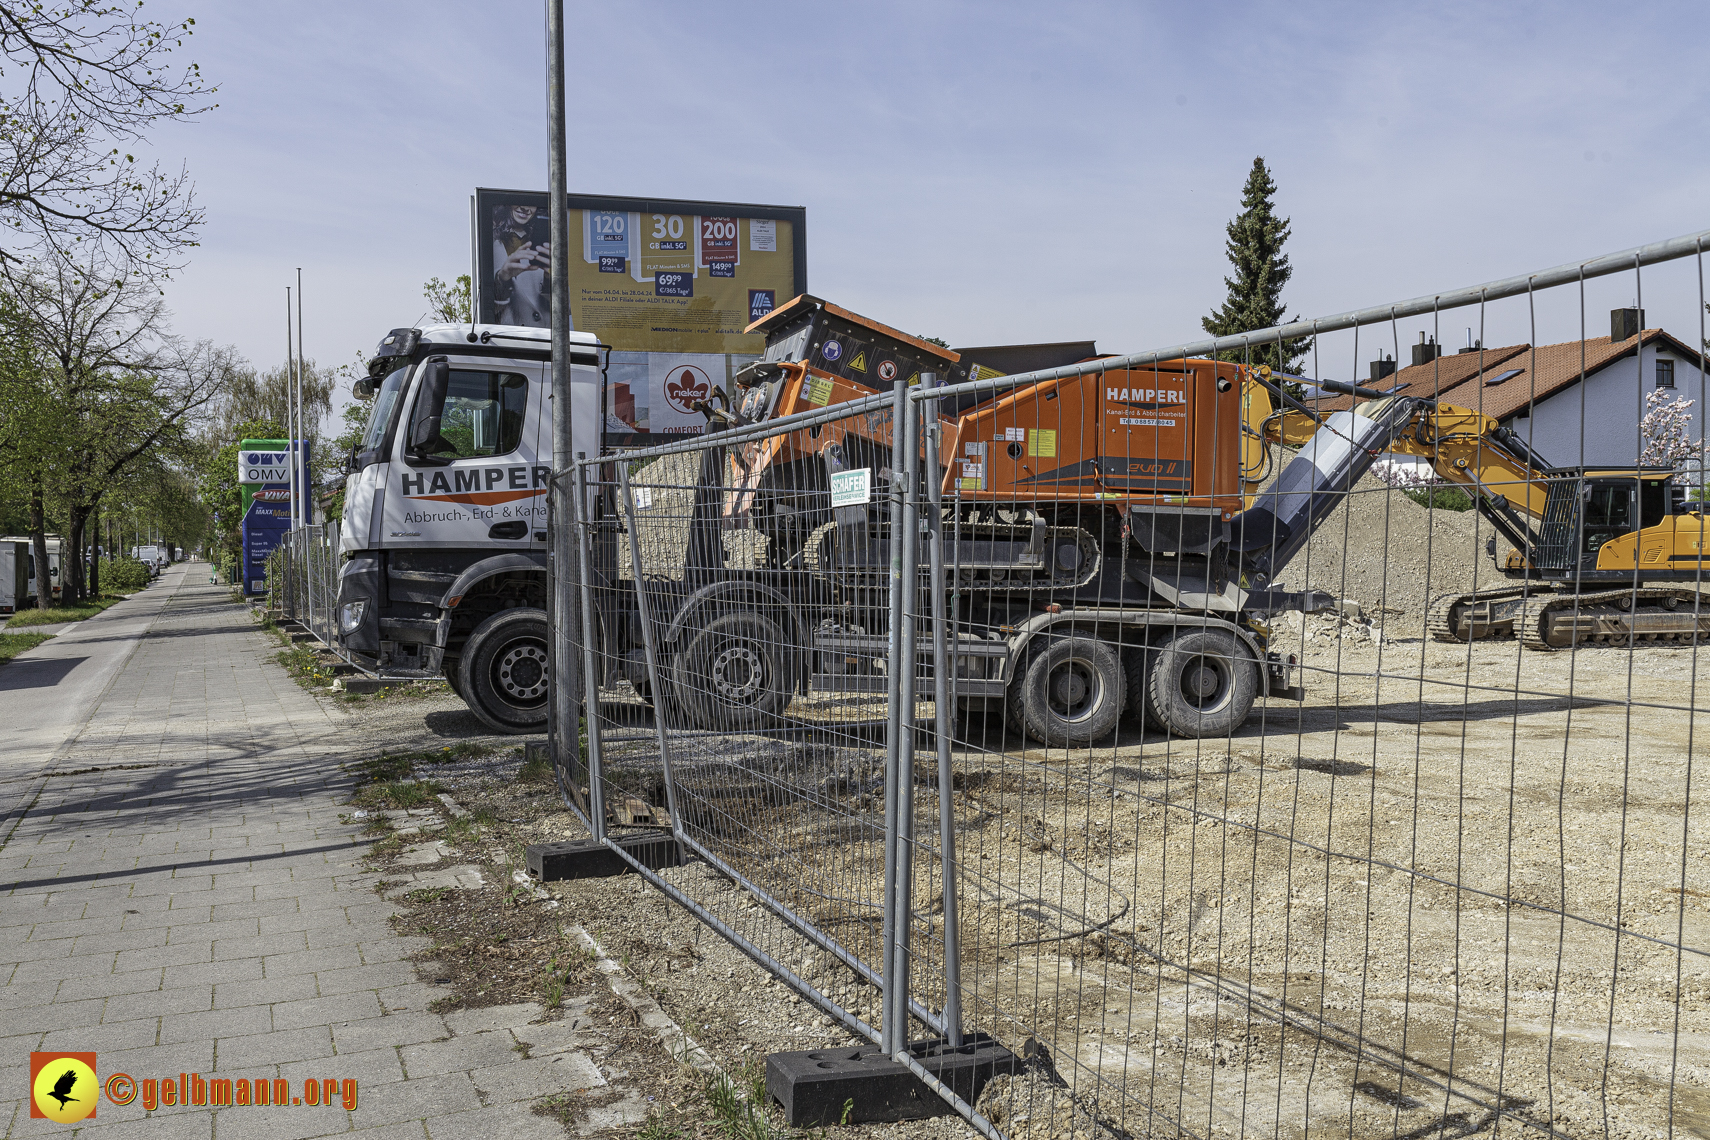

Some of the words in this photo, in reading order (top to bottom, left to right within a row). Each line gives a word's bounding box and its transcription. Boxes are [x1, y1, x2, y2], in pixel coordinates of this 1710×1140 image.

[593, 215, 625, 233] 120
[651, 213, 684, 239] 30
[703, 221, 736, 239] 200
[650, 242, 660, 250] GB
[674, 388, 704, 398] rieker
[1106, 387, 1187, 404] HAMPERL
[248, 469, 287, 480] OMV
[1128, 463, 1164, 473] evo
[402, 466, 550, 496] HAMPER
[832, 474, 865, 494] SCHÄFER
[264, 492, 290, 500] VIVA
[404, 509, 471, 524] Abbruch-,
[472, 507, 498, 520] Erd-
[502, 506, 512, 518] &
[515, 506, 546, 516] Kana
